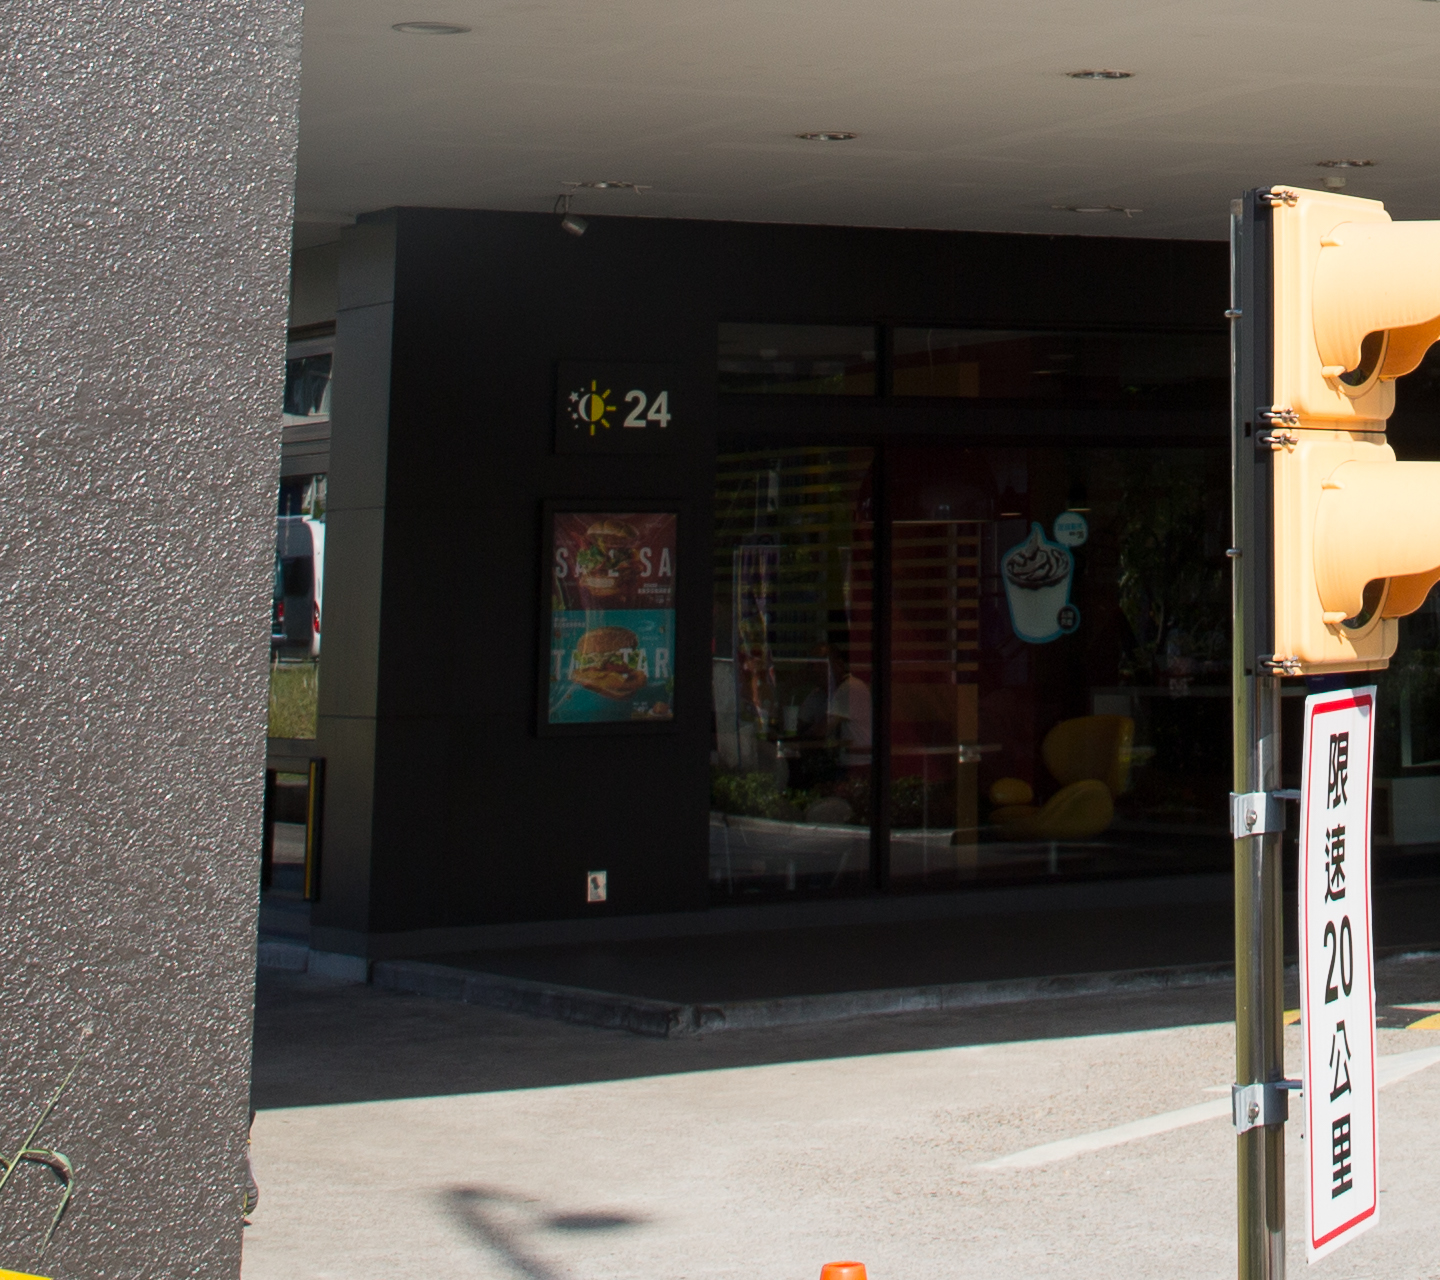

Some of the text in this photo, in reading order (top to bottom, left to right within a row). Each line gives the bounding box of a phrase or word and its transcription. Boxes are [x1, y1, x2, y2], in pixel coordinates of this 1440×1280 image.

[623, 389, 672, 429] 24
[551, 647, 670, 681] TATAR
[1323, 732, 1354, 1201] 限速20公里
